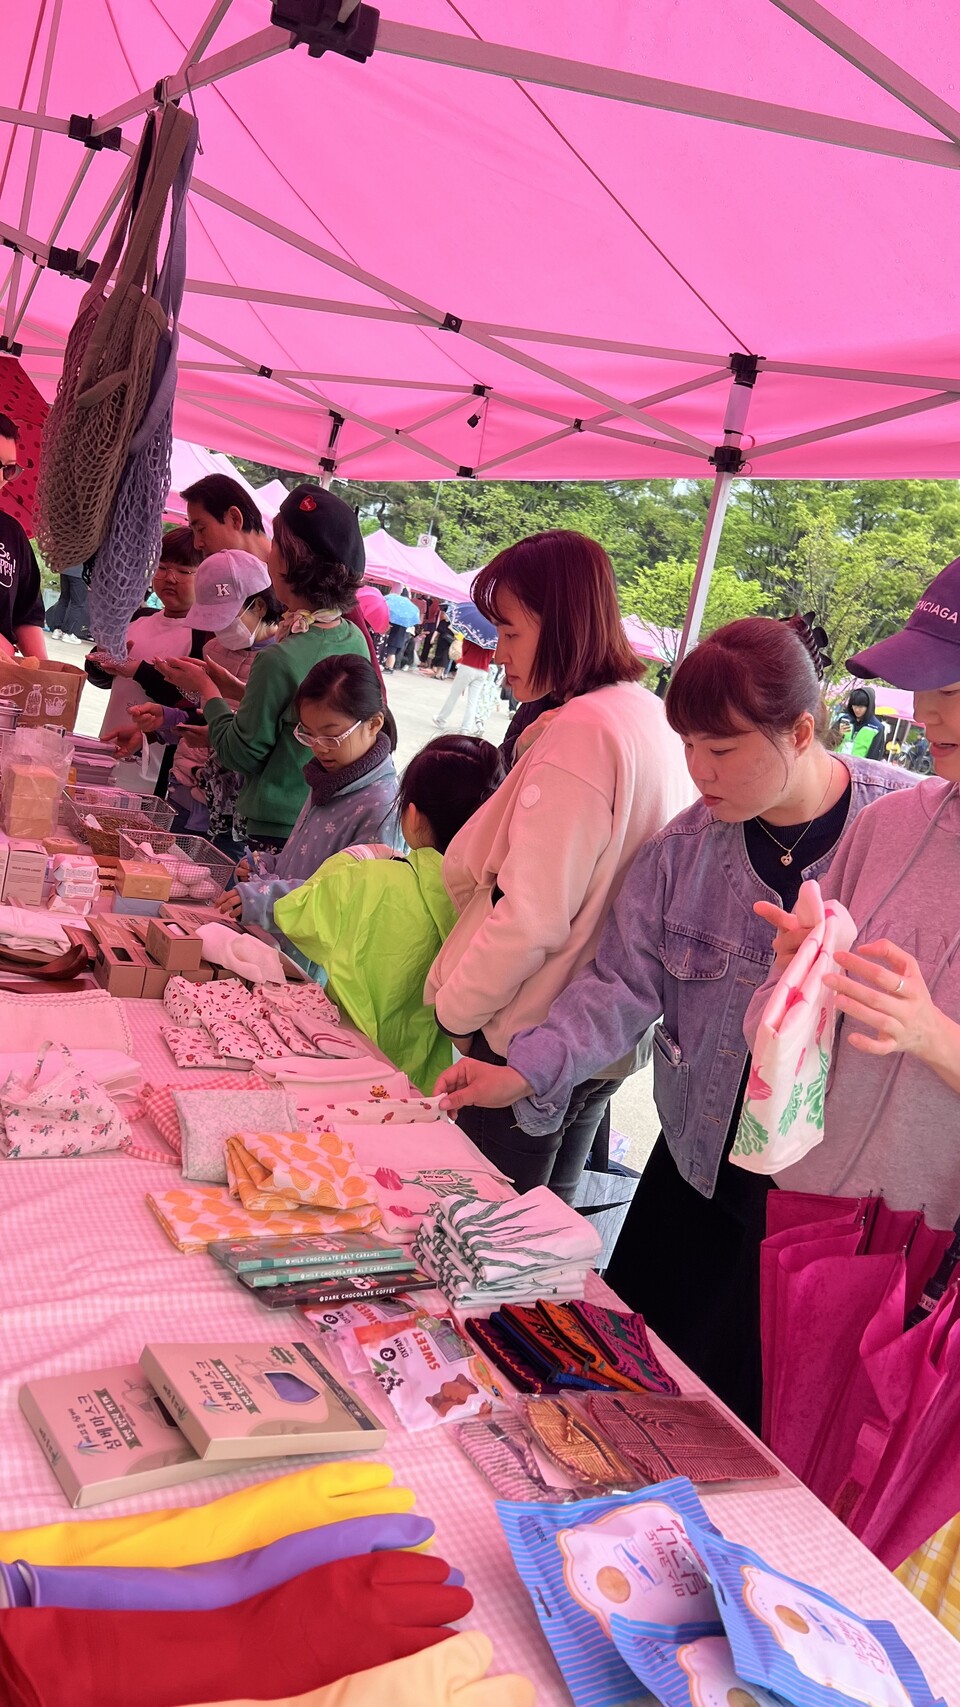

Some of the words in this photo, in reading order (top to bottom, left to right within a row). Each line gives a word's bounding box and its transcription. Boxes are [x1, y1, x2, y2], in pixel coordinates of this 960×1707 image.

[215, 583, 230, 597] K
[306, 1255, 339, 1263] CHOCOLATE
[355, 1251, 380, 1259] CARAMEL
[320, 1269, 353, 1278] CHOCOLATE
[369, 1265, 394, 1273] CARAMEL
[341, 1291, 374, 1300] CHOCOLATE
[352, 1303, 382, 1326] SWEET
[394, 1337, 410, 1359] OXFAM
[412, 1331, 441, 1371] SWEET
[196, 1361, 243, 1412] 삼베마스크
[77, 1393, 123, 1451] 삼베마스크
[645, 1529, 686, 1597] 마스코바도
[656, 1525, 708, 1596] 달고나
